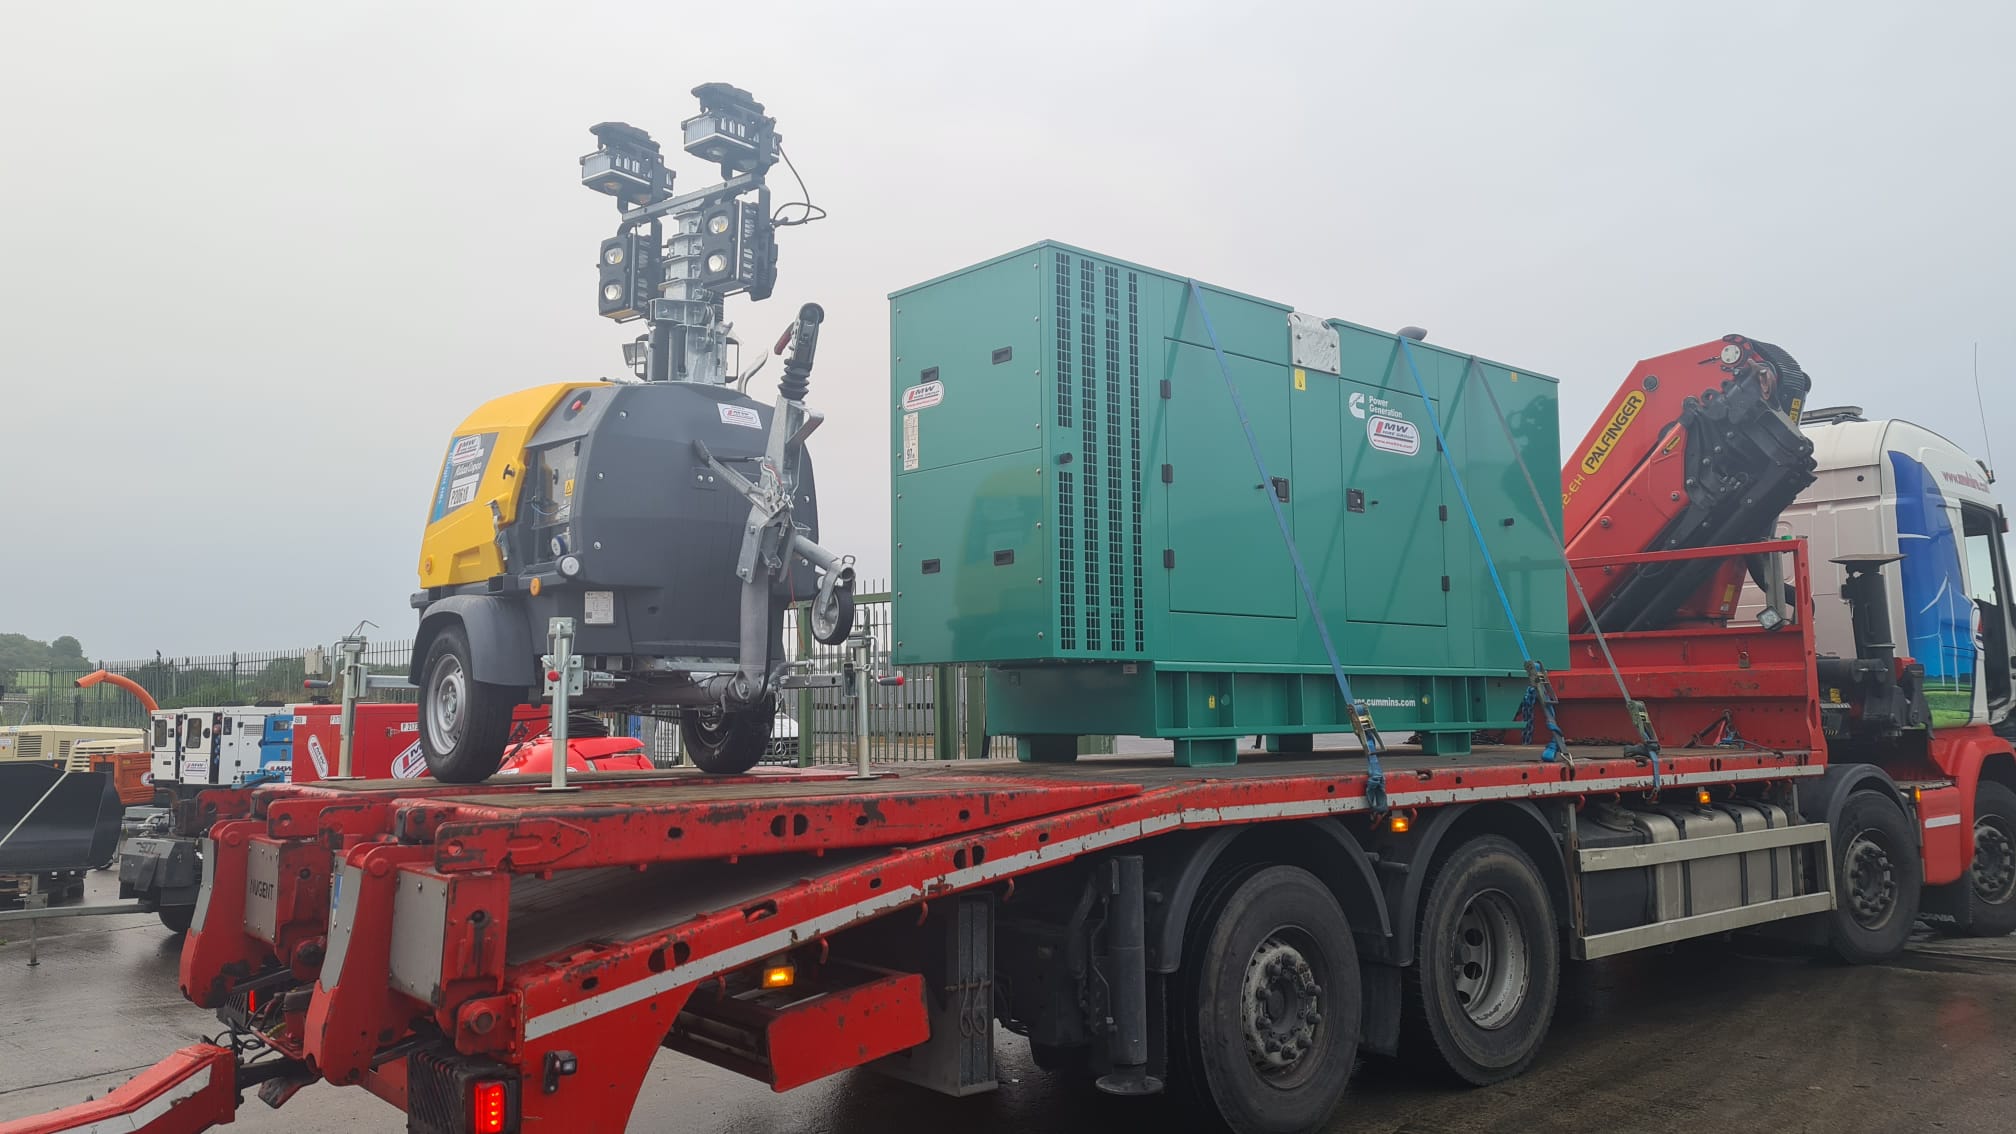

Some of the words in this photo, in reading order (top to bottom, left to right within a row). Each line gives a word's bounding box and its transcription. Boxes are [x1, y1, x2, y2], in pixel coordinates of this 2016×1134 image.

[1369, 396, 1388, 406] Power
[1369, 404, 1402, 418] Generation
[1584, 395, 1642, 470] PALFINGER
[249, 879, 274, 901] NUGENT
